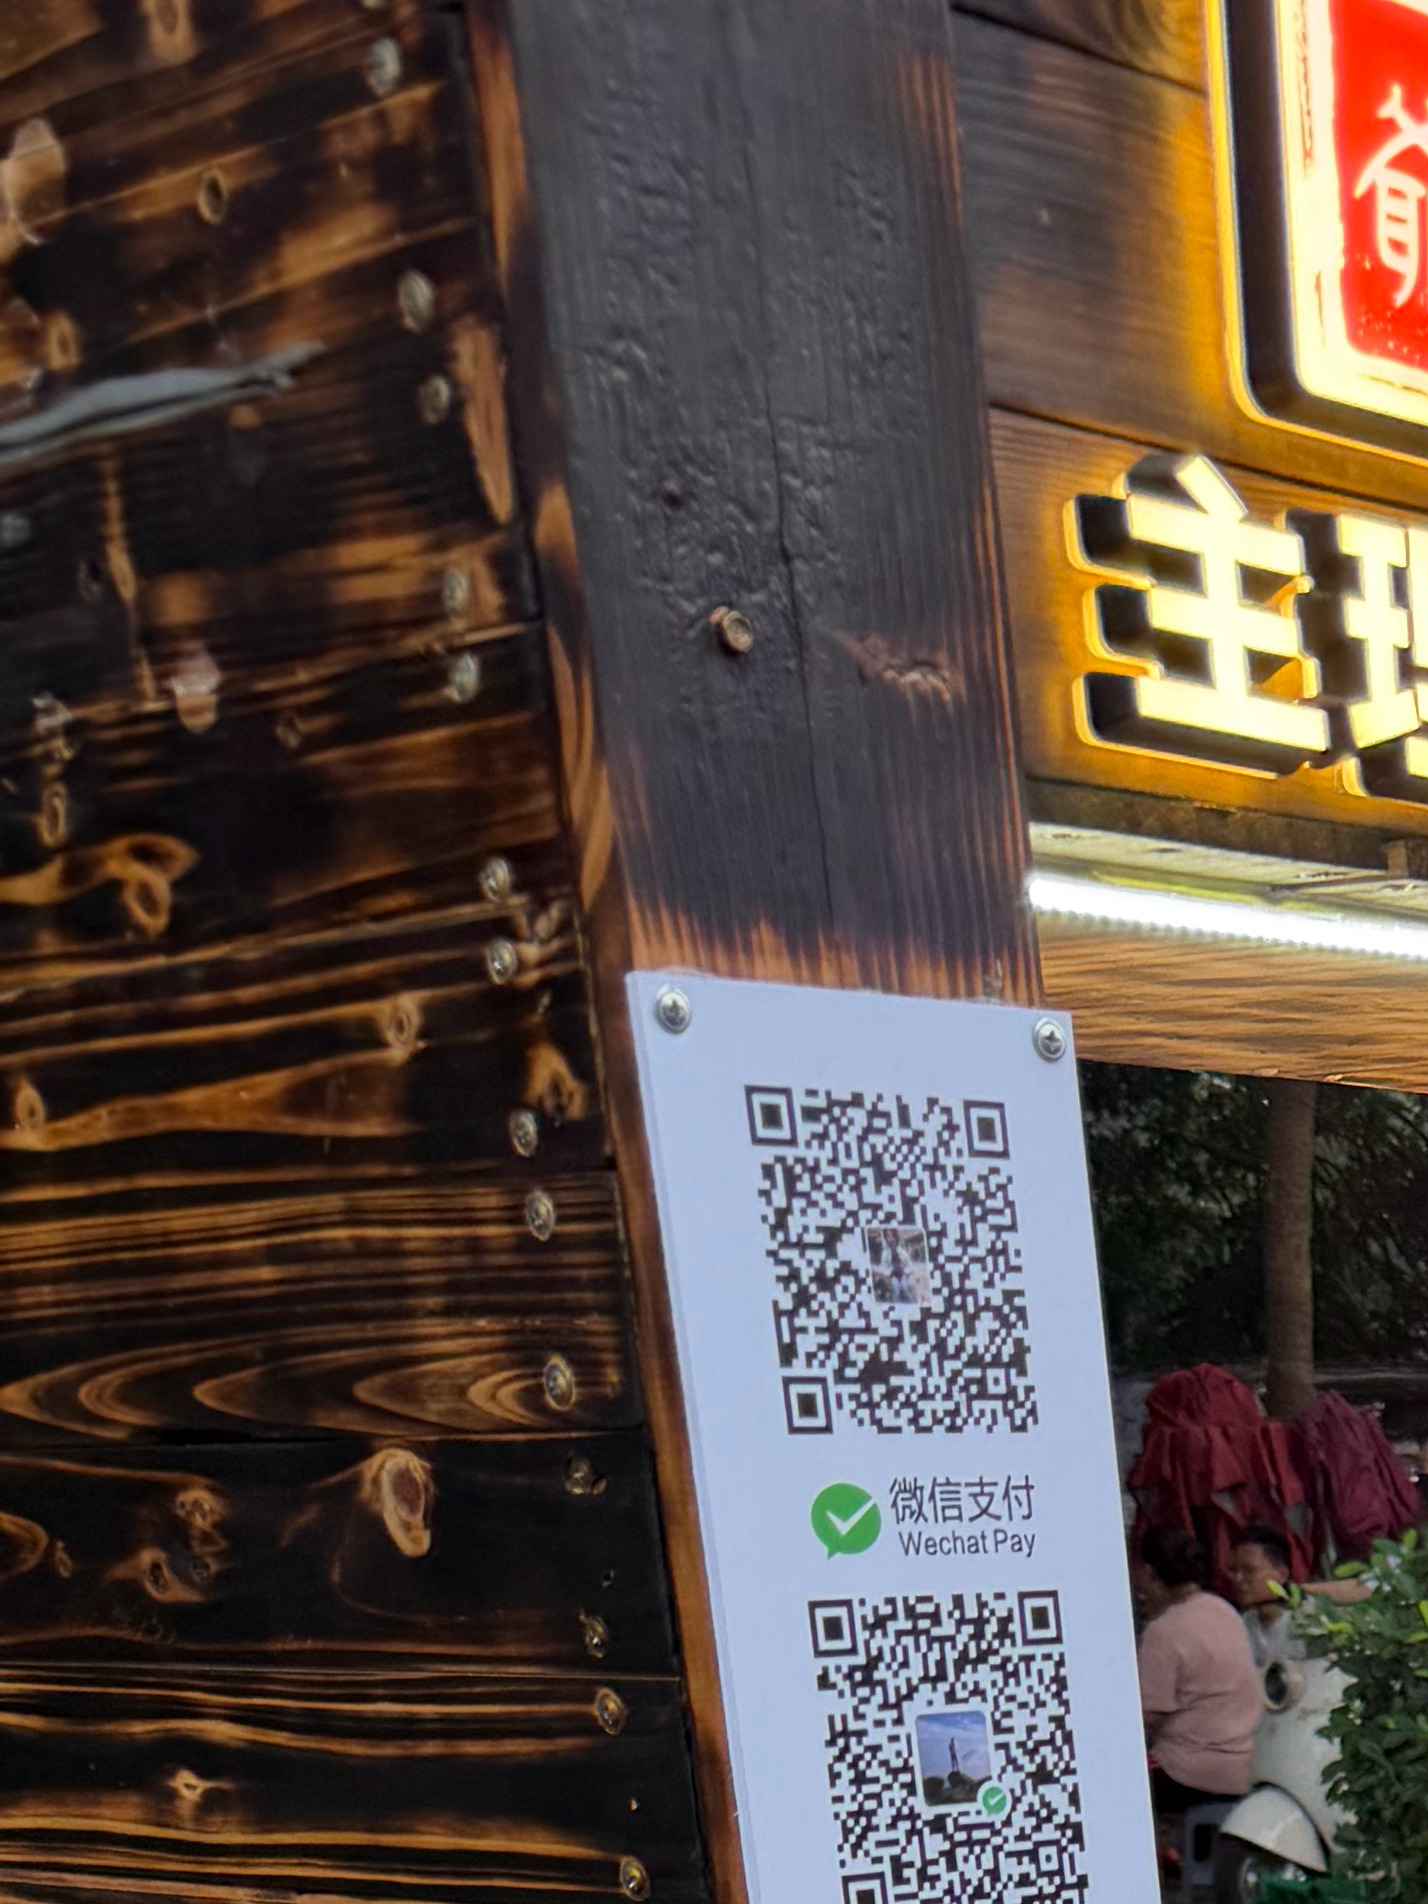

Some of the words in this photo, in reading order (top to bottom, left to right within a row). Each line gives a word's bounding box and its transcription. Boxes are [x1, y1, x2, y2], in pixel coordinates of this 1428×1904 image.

[889, 1474, 1035, 1525] 微信支付
[898, 1529, 988, 1556] Wechat
[993, 1528, 1036, 1558] Pay
